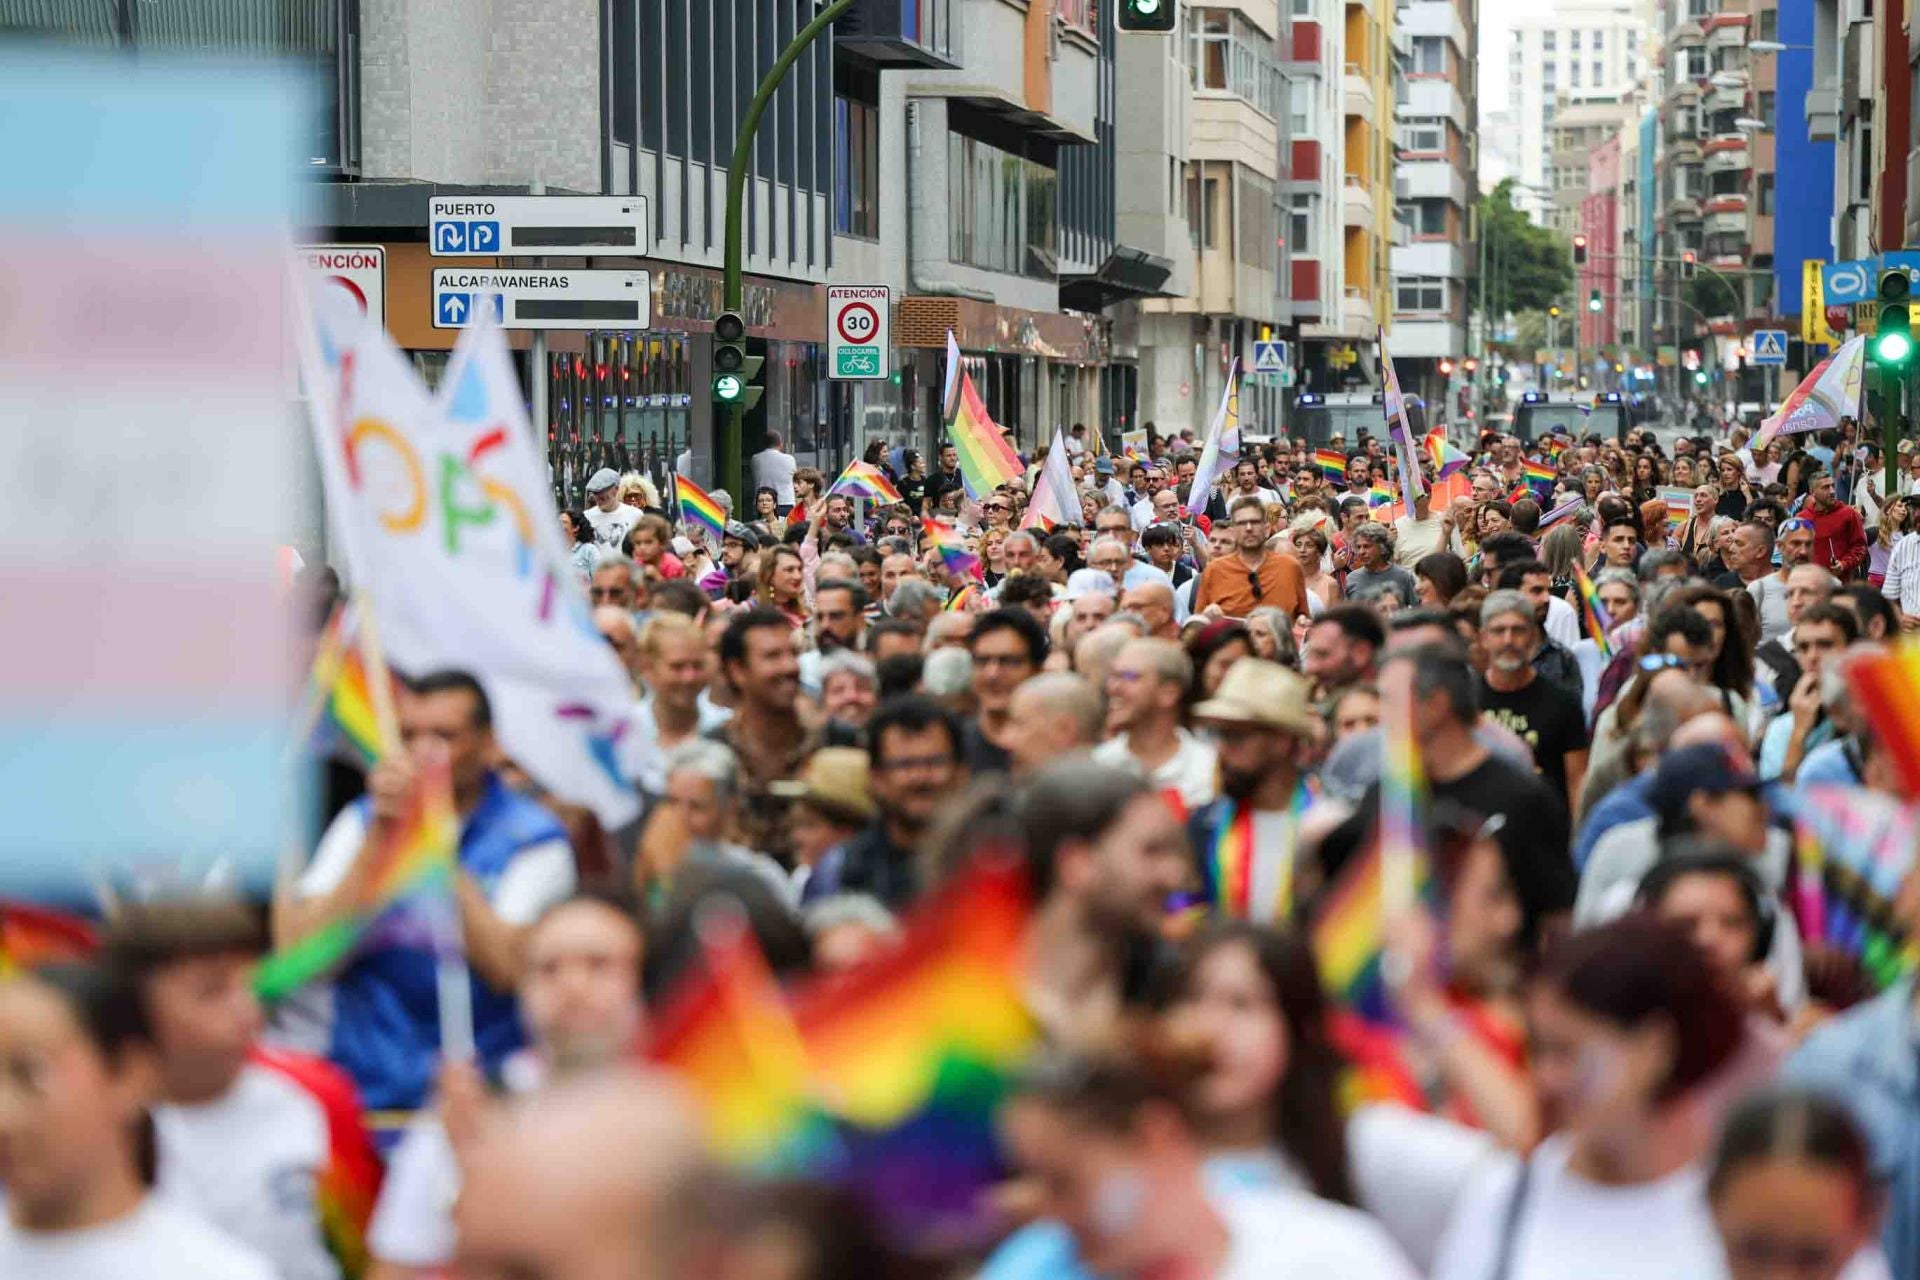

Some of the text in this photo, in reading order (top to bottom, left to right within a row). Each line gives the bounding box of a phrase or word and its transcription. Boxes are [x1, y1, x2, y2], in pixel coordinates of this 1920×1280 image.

[434, 203, 495, 215] PUERTO
[439, 275, 569, 289] ALCARAVANERAS
[830, 288, 886, 298] ATENCIÓN
[847, 316, 870, 330] 30
